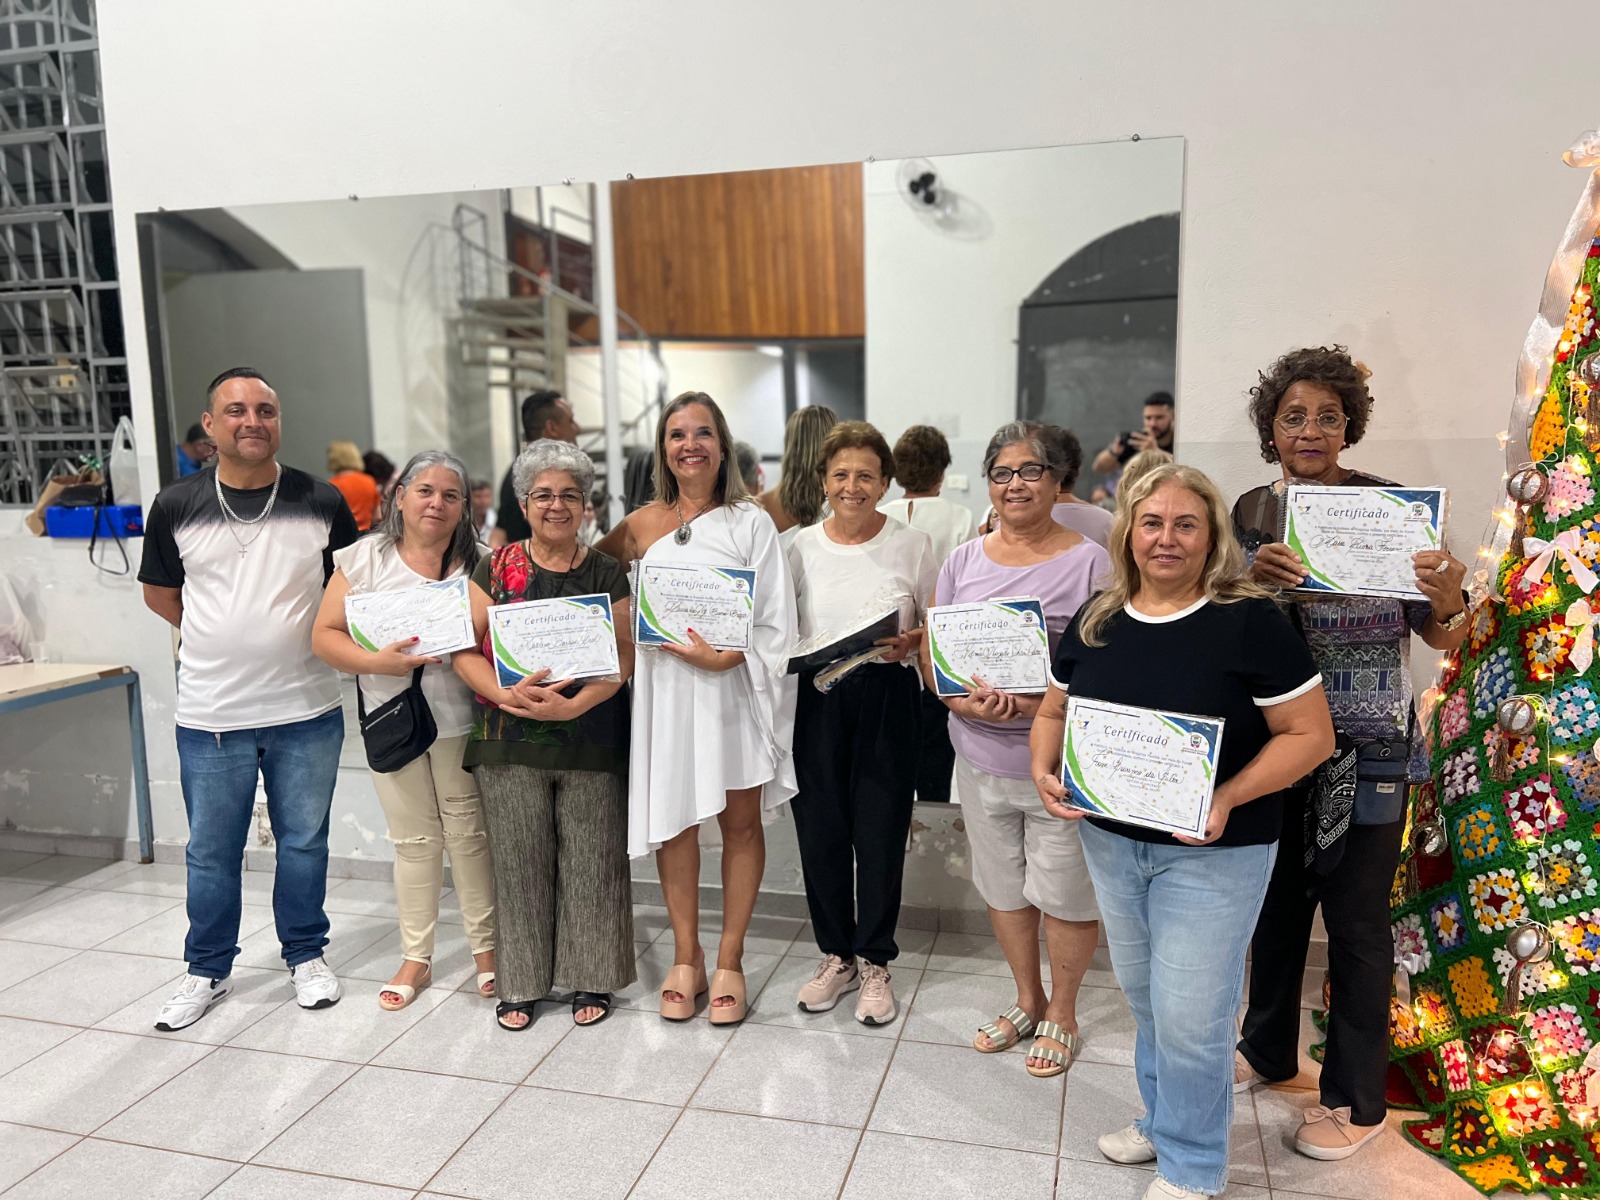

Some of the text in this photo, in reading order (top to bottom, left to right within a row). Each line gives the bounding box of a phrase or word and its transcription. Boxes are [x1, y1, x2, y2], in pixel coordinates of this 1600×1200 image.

[1327, 507, 1389, 519] Certificado
[670, 579, 721, 591] Certificado
[524, 612, 577, 626] Certificado
[959, 620, 1009, 631] Certificado
[1103, 725, 1168, 746] Certificado
